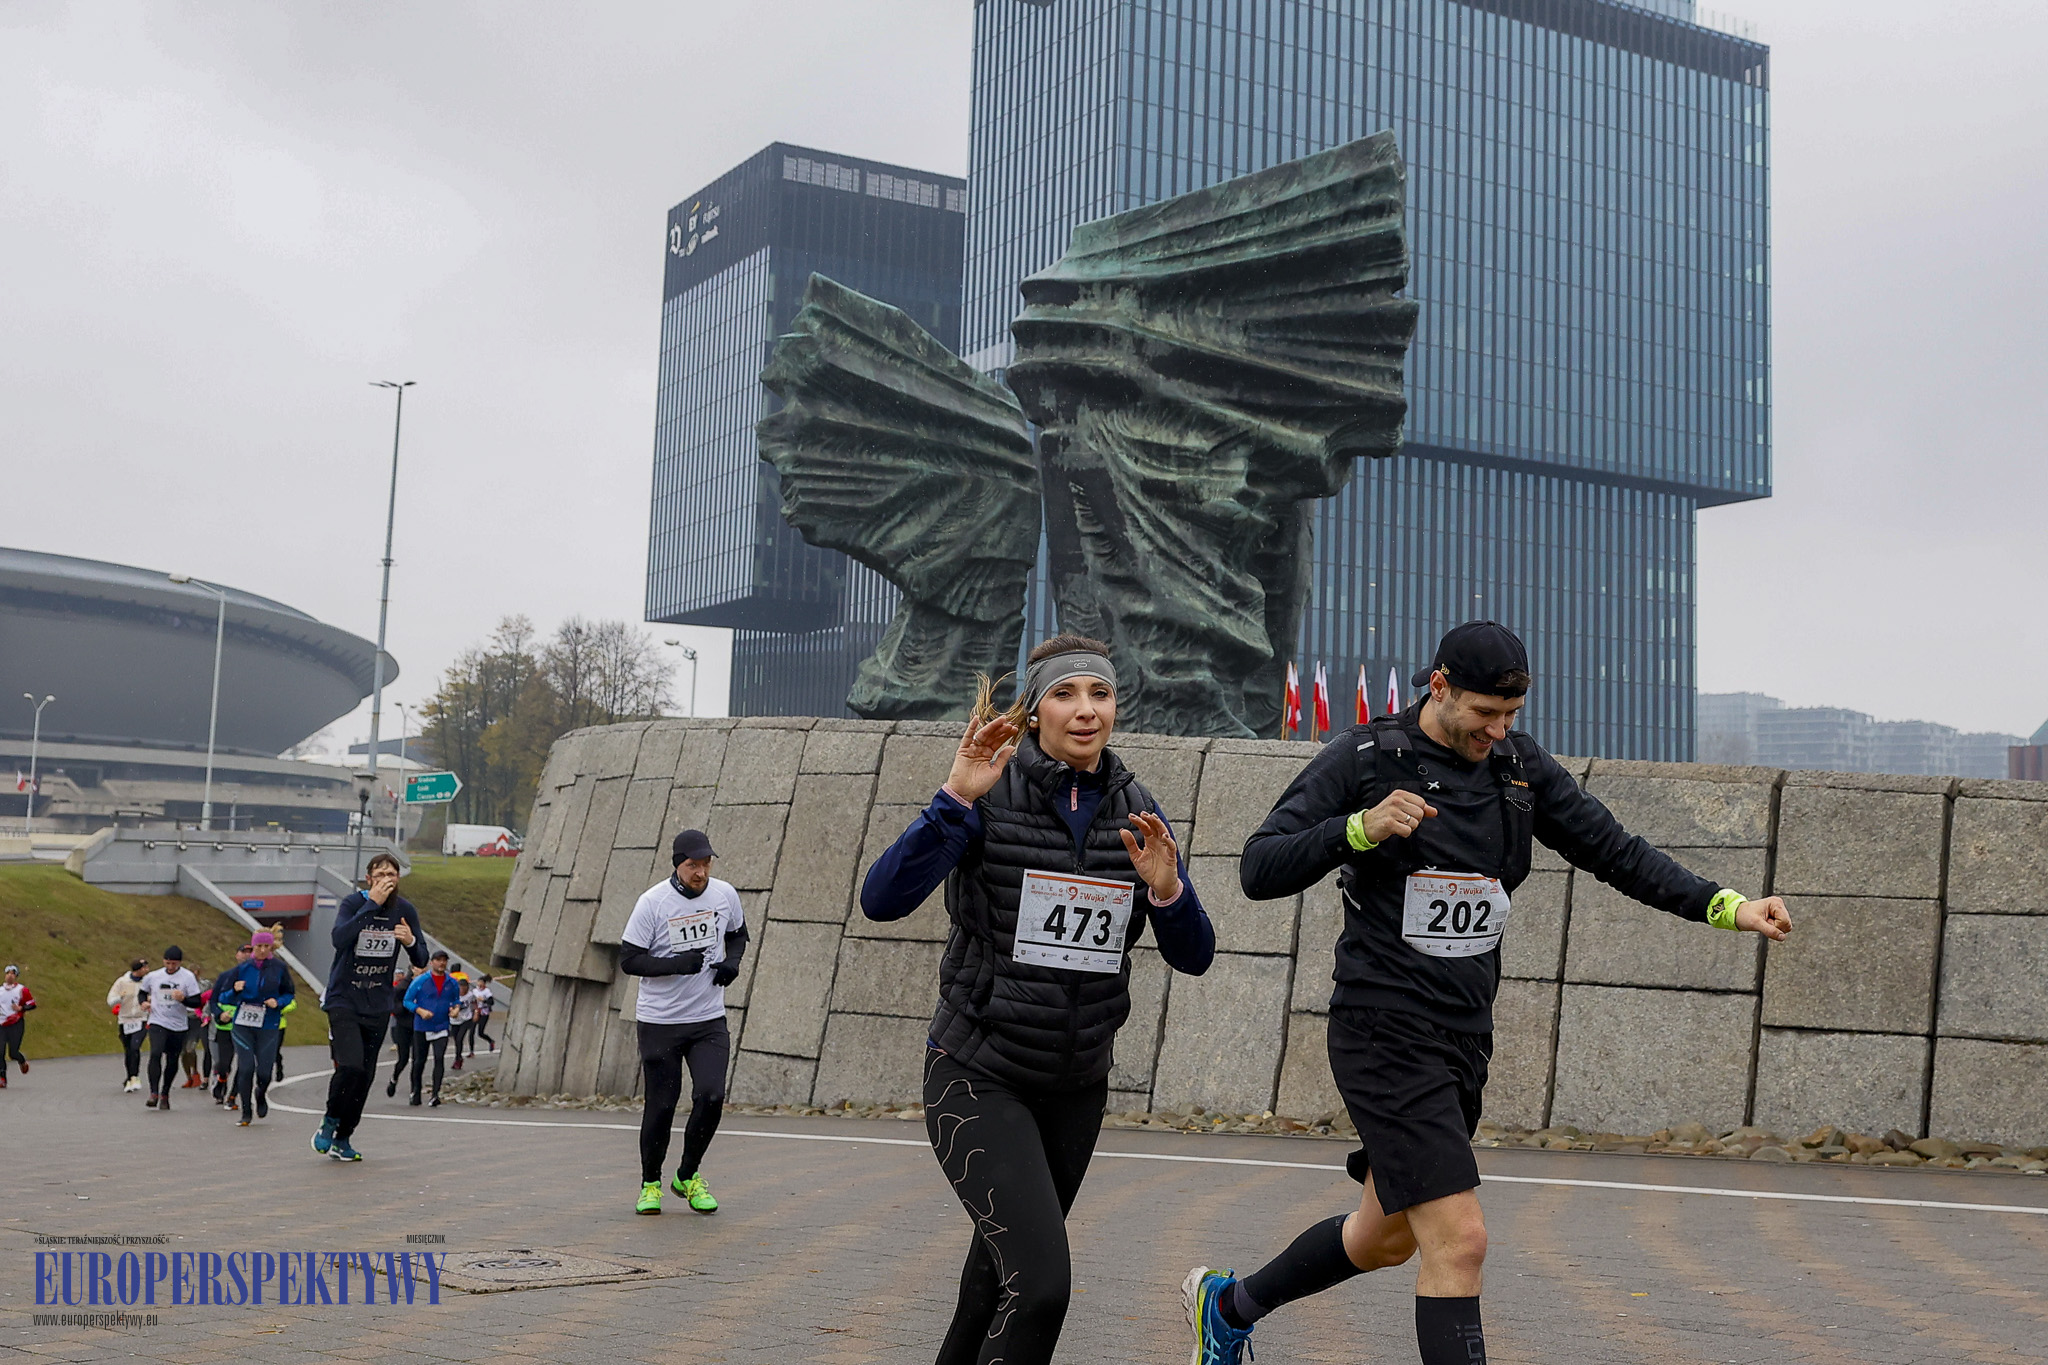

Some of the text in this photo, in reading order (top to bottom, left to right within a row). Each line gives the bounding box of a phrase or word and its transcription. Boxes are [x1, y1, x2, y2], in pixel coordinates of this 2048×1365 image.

[1043, 904, 1112, 946] 473
[1427, 899, 1491, 934] 202
[365, 939, 388, 950] 379
[680, 923, 707, 941] 119
